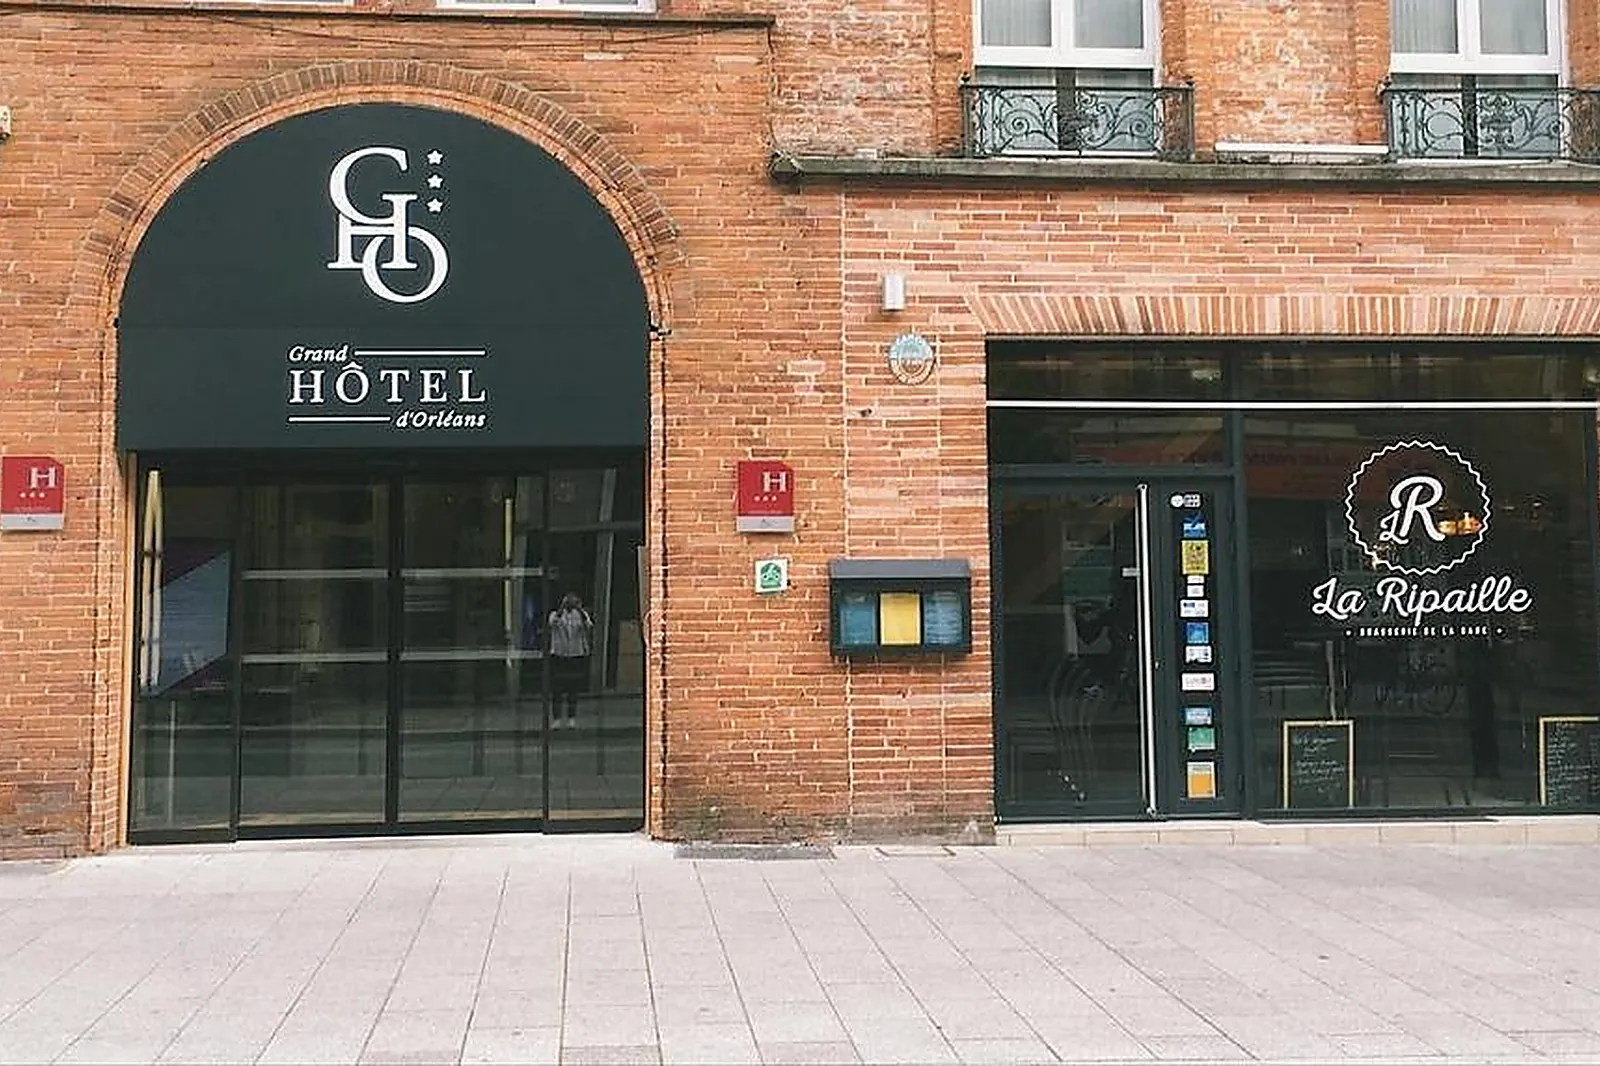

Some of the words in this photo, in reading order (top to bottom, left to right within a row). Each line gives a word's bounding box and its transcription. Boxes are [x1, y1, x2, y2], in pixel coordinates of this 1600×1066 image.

[289, 345, 349, 362] Grand
[289, 361, 486, 403] HÔTEL
[396, 410, 486, 428] d'Orléans
[30, 466, 56, 489] H
[763, 471, 786, 492] H
[1312, 577, 1367, 620] La
[1376, 575, 1533, 627] Ripaille
[1442, 625, 1456, 636] LA
